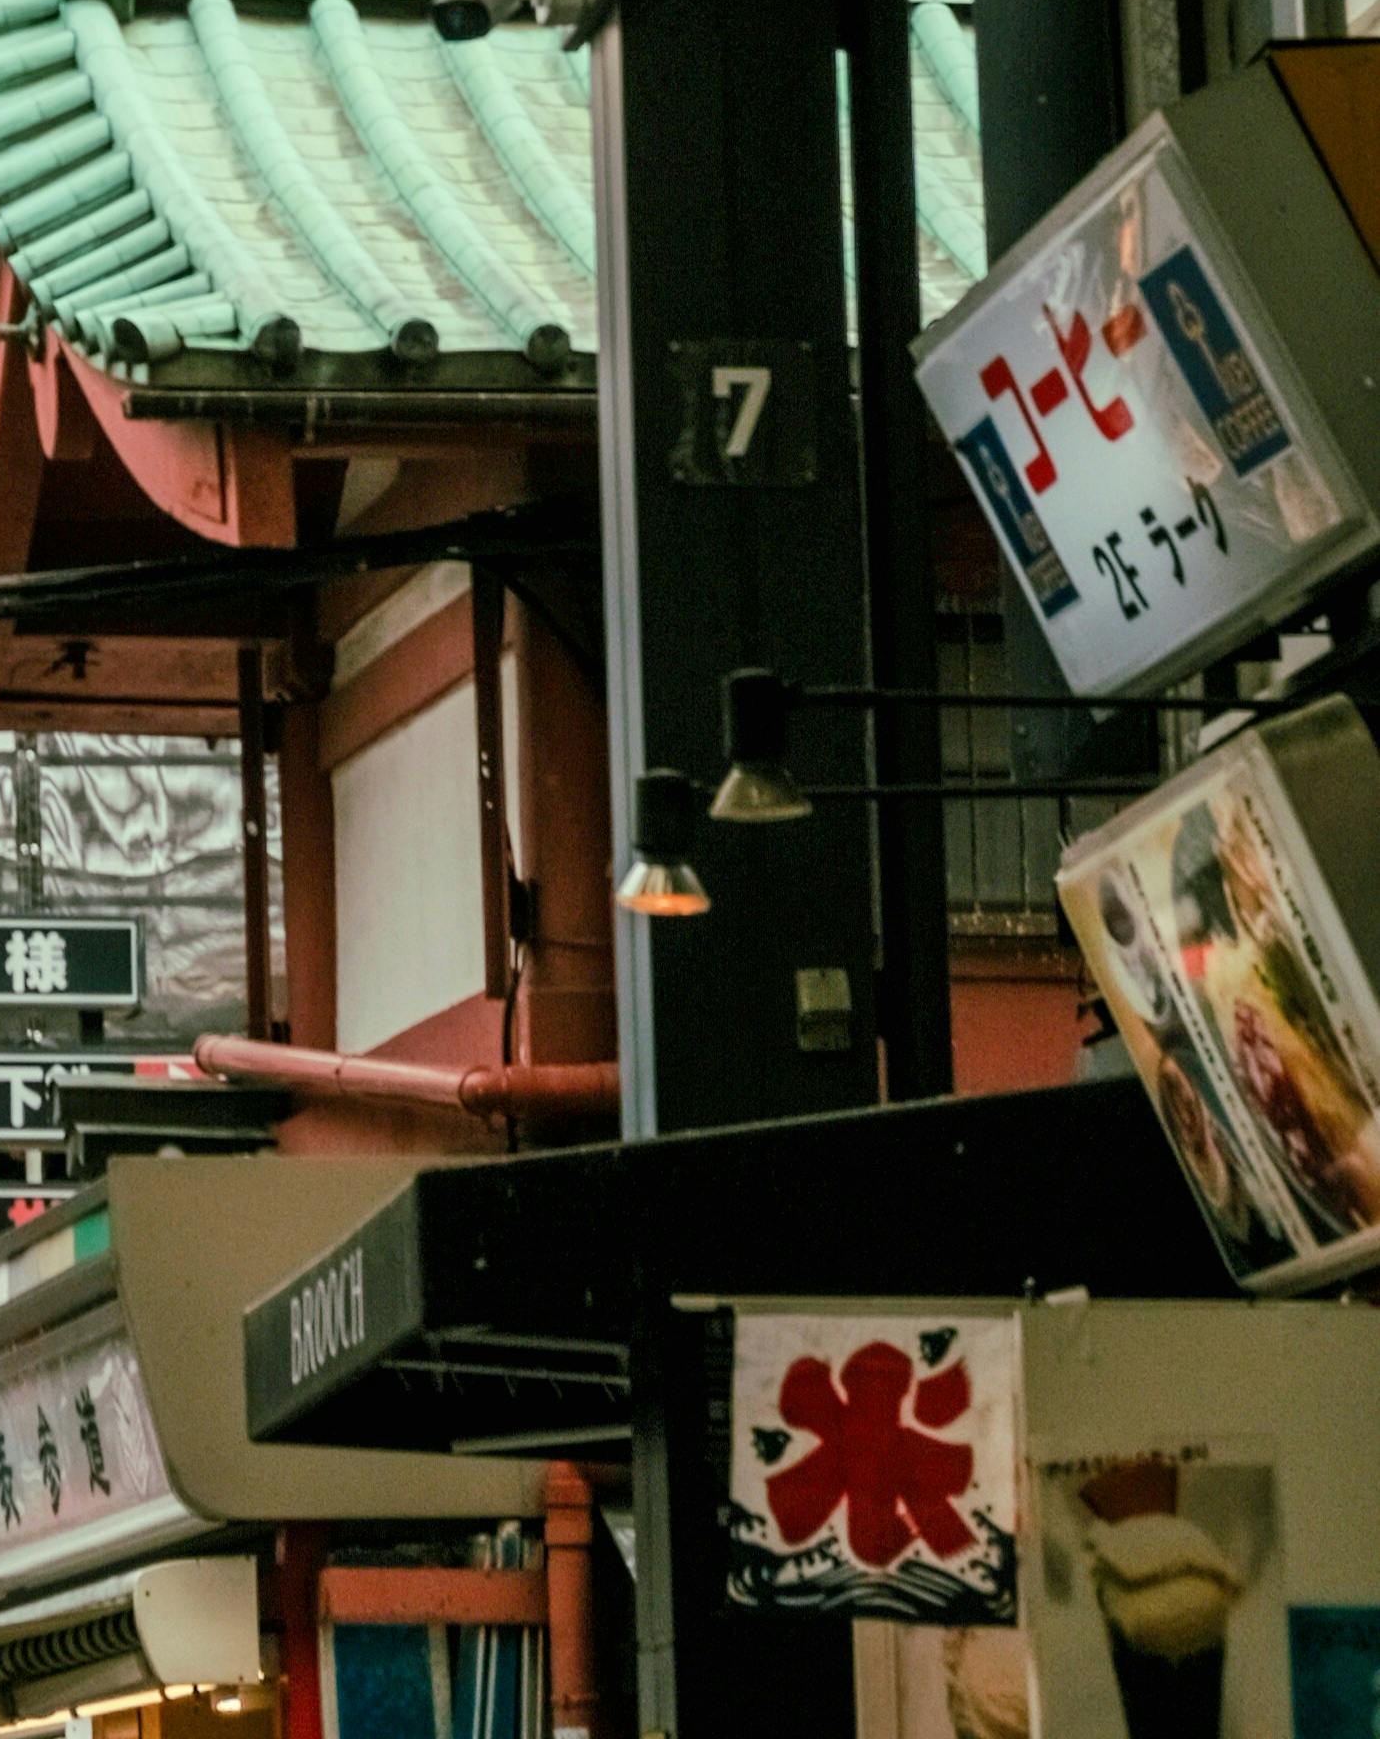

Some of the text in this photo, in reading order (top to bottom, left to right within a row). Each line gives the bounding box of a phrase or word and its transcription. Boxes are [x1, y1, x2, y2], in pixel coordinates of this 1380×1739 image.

[712, 367, 771, 457] 7
[979, 304, 1147, 495] コーヒー
[1093, 531, 1149, 622] 2F
[1140, 477, 1231, 586] ラーク
[290, 1247, 364, 1385] BROOCH
[765, 1339, 978, 1567] 氷
